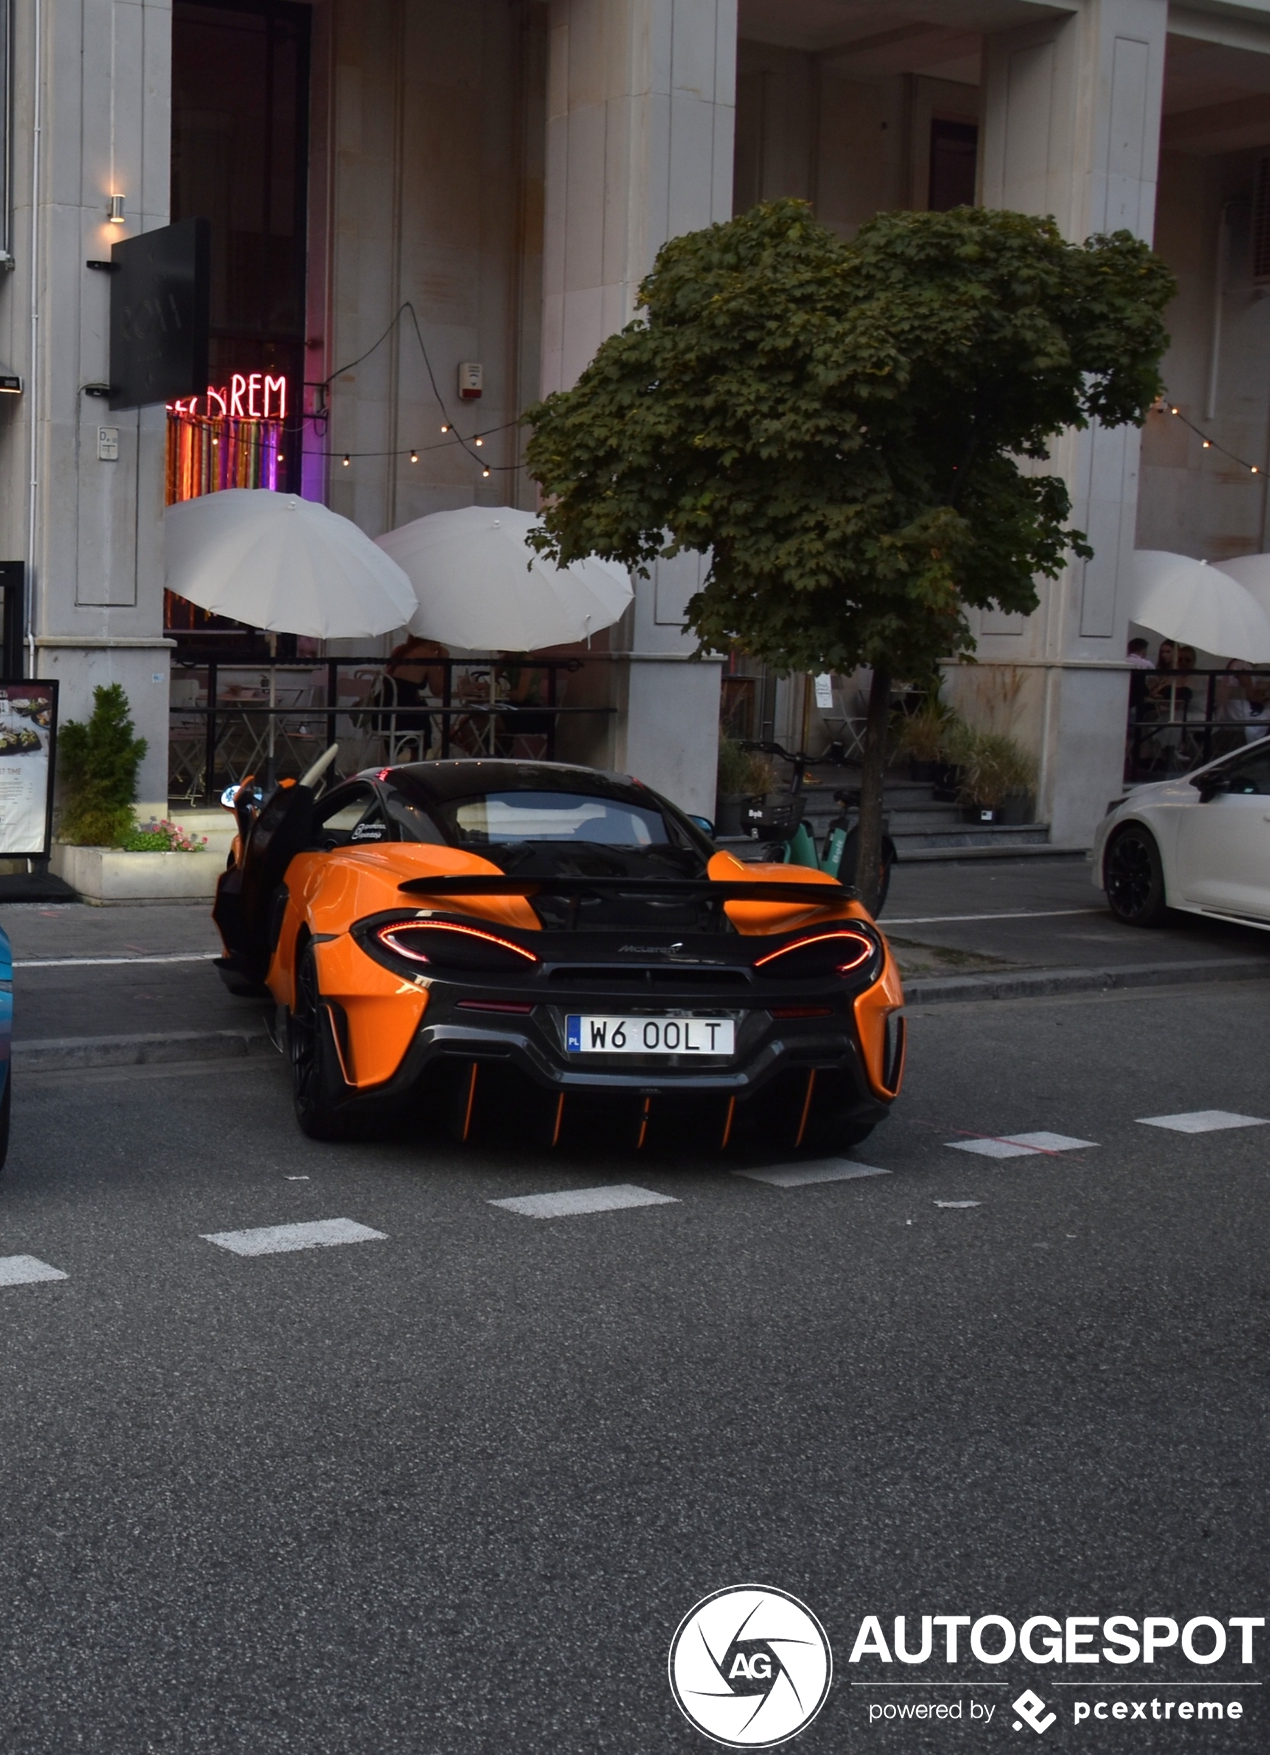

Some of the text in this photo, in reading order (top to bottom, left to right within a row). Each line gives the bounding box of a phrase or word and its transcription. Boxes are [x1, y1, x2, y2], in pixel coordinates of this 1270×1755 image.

[7, 767, 22, 775] TIME
[748, 809, 763, 819] Bolt
[618, 944, 677, 954] McLaren
[590, 1021, 627, 1049] W6
[568, 1037, 579, 1046] PL
